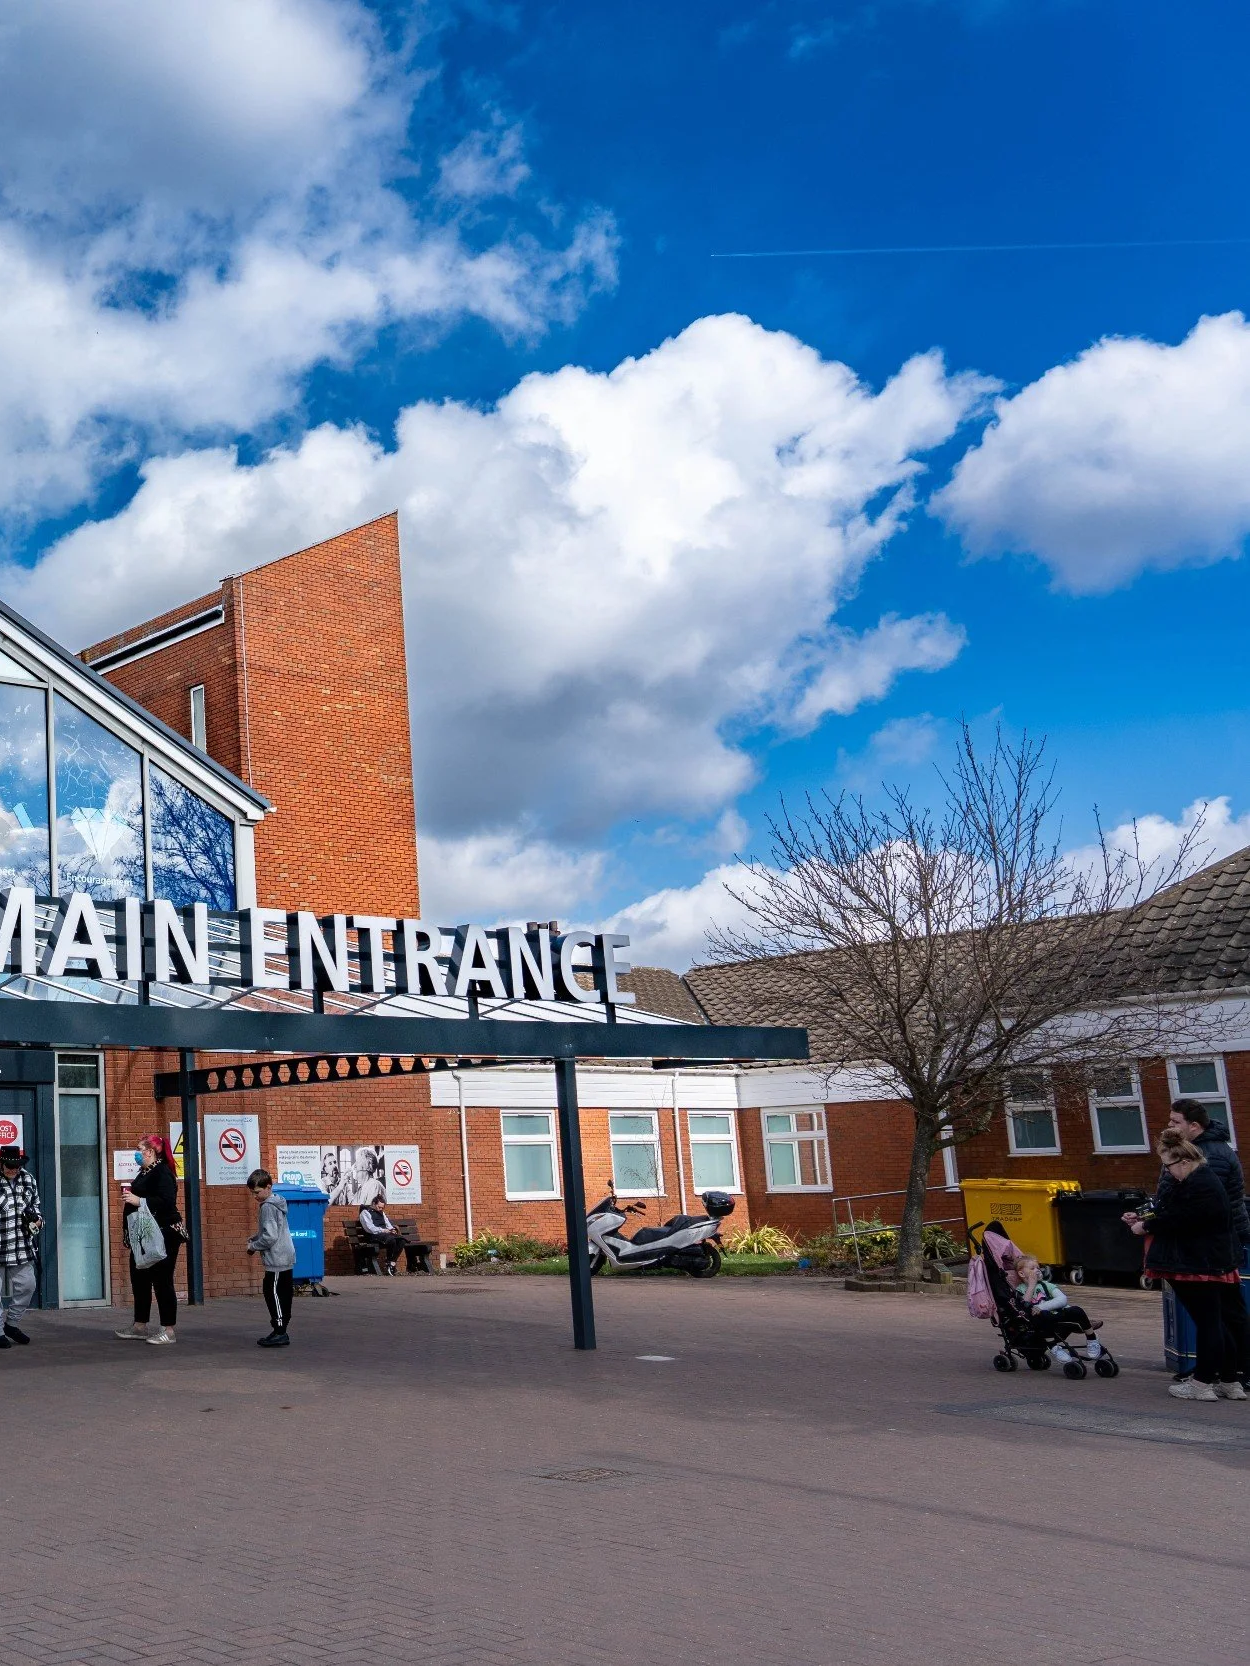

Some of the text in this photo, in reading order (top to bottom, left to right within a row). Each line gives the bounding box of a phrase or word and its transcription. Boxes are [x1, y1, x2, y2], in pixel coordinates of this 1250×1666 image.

[66, 871, 134, 888] Encouragement
[250, 907, 636, 1003] ENTRANCE
[283, 1173, 302, 1181] PROUD
